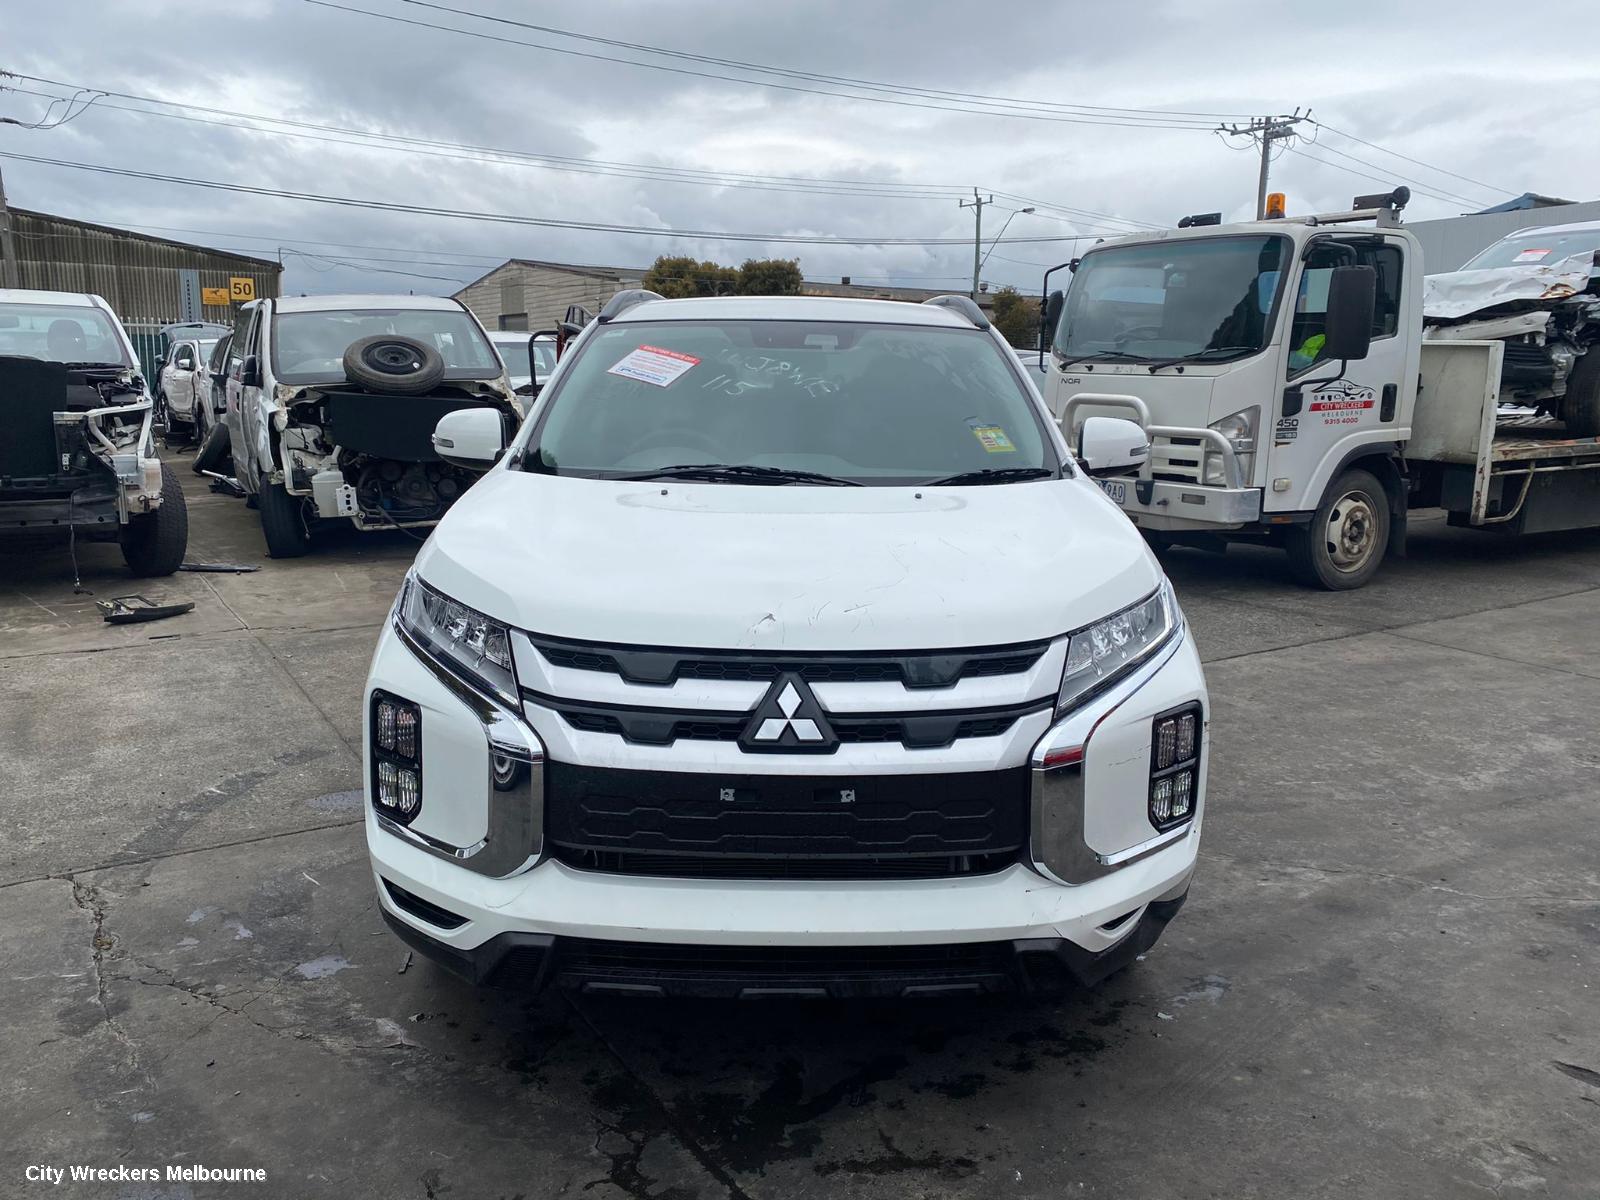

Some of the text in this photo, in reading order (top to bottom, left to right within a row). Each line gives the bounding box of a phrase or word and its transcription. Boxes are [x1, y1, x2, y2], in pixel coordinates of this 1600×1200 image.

[233, 282, 252, 296] 50
[1335, 401, 1365, 409] WRECKERS
[1276, 419, 1299, 427] 450
